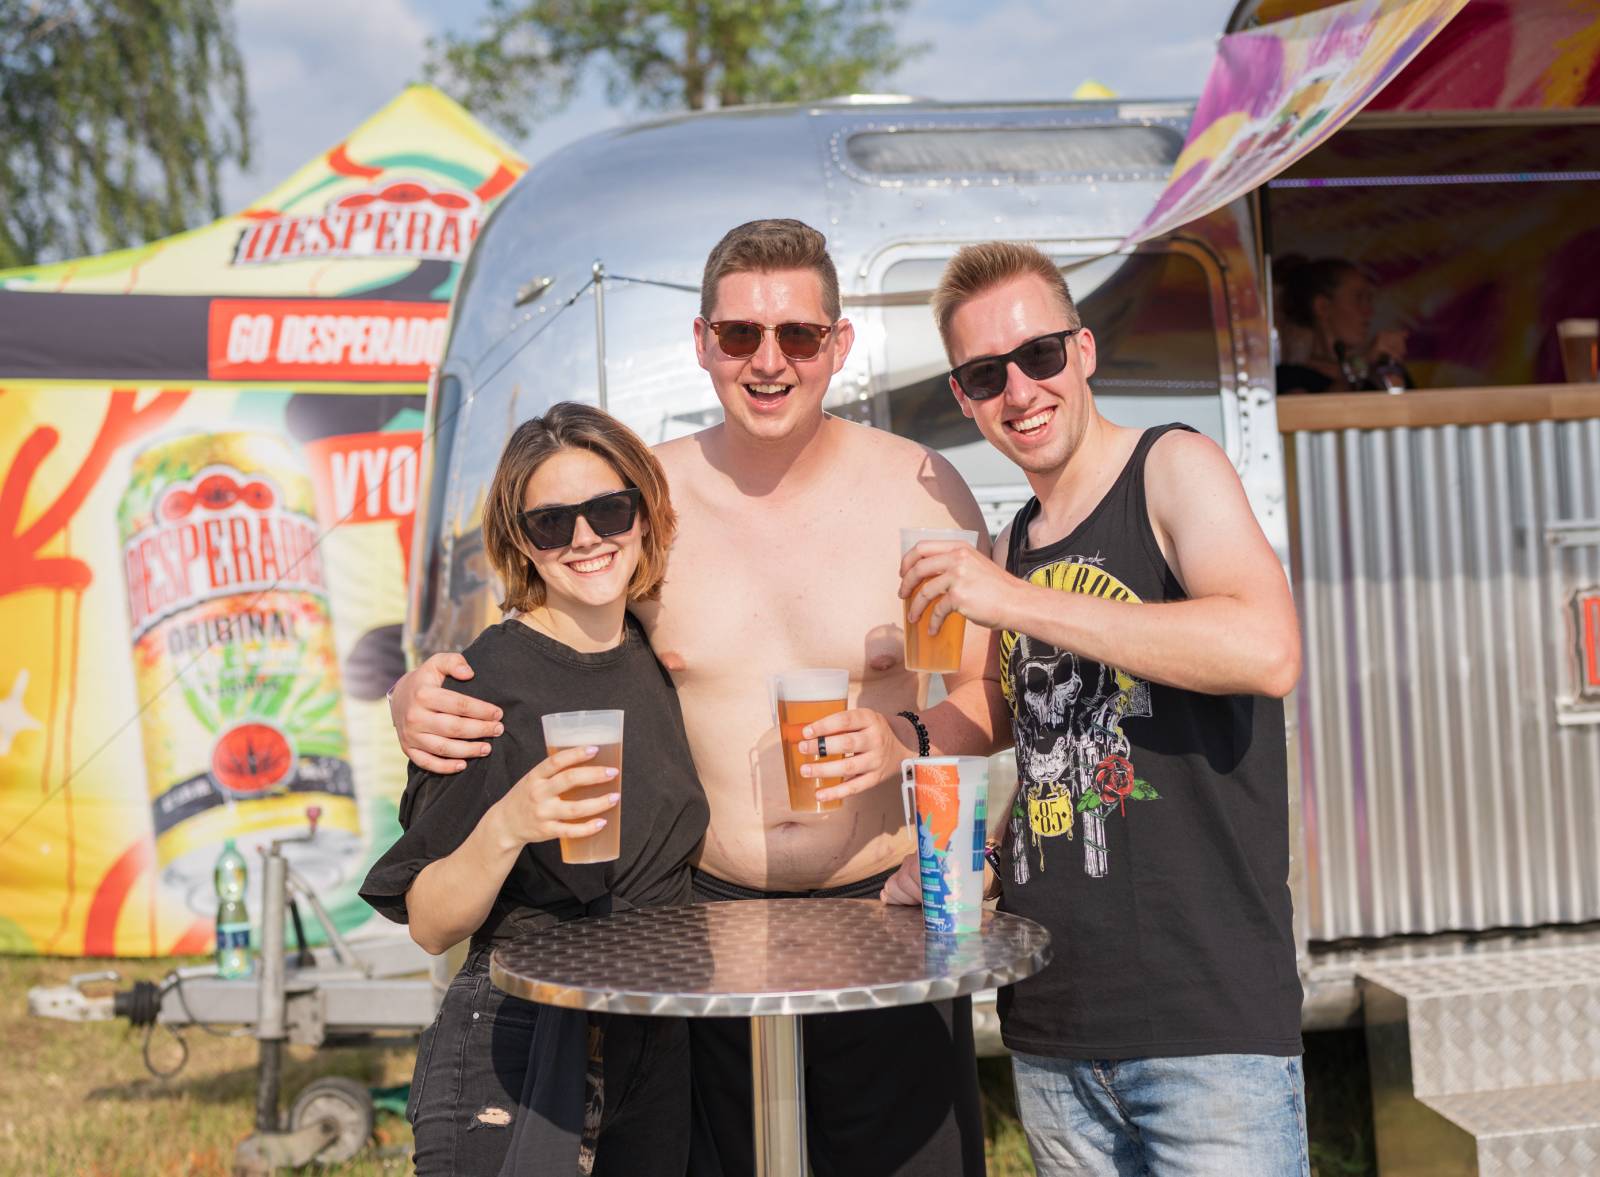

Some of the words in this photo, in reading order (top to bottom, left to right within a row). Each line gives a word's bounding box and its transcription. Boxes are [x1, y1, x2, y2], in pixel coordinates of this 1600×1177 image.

[227, 313, 273, 364] GO
[330, 445, 417, 520] VYO
[167, 611, 300, 656] ORIGINAL
[1039, 801, 1063, 833] 85
